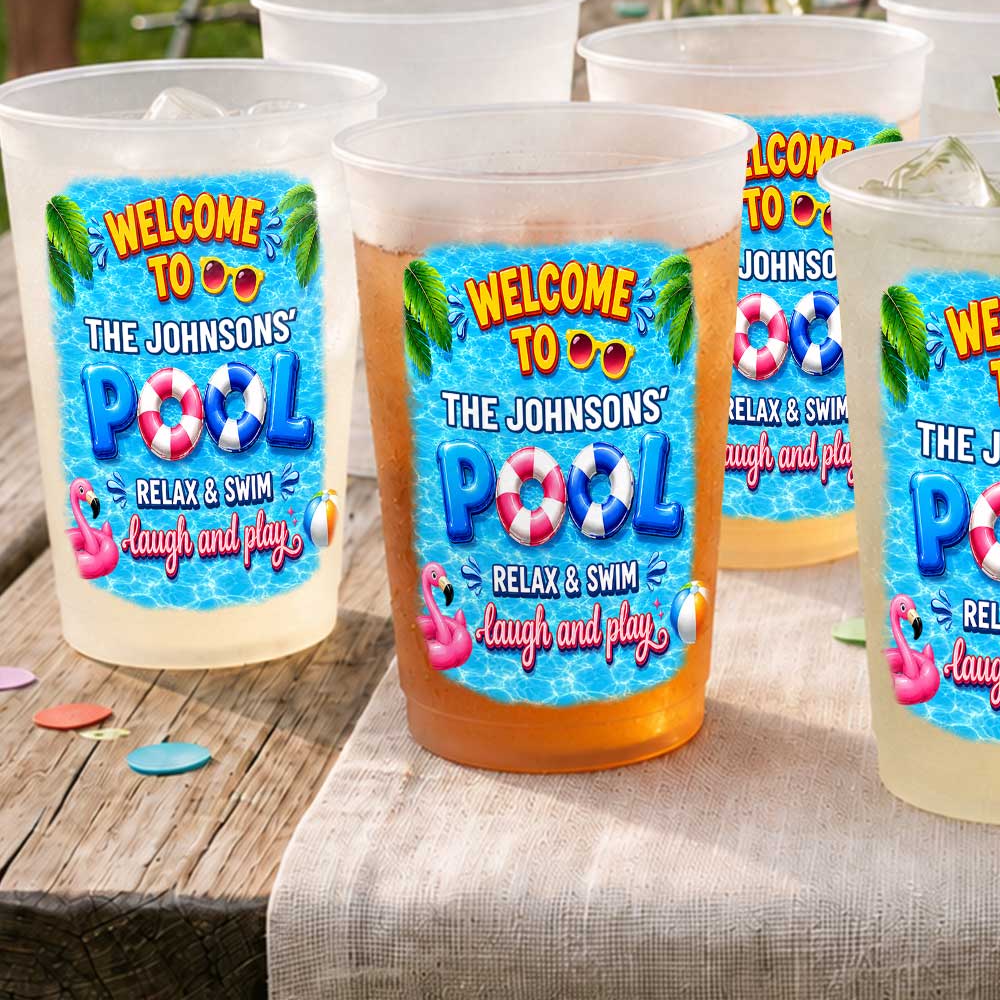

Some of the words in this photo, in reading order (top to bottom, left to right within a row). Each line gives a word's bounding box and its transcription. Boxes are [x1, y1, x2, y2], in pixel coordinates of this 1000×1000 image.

[746, 131, 856, 181] LCOM
[104, 192, 266, 260] WELCOME
[743, 185, 785, 232] TO
[148, 252, 193, 301] TO
[739, 249, 837, 282] JOHNSO
[464, 261, 637, 331] WELCOME
[84, 317, 138, 353] THE
[145, 307, 299, 355] JOHNSONS'
[510, 324, 559, 375] TO
[733, 290, 843, 381] OO
[80, 351, 314, 461] POOL
[441, 390, 499, 432] THE
[505, 386, 669, 434] JOHNSONS'
[786, 396, 801, 427] &
[805, 394, 848, 426] SWIM
[725, 430, 775, 491] augh
[777, 430, 819, 472] and
[915, 419, 974, 464] THE
[135, 477, 200, 508] RELAX
[204, 478, 219, 506] &
[224, 472, 273, 503] SWIM
[436, 431, 684, 546] POOL
[121, 513, 192, 579] laugh
[198, 512, 240, 558] and
[243, 509, 303, 572] play
[492, 563, 560, 599] RELAX
[564, 564, 580, 597] &
[585, 560, 639, 594] SWIM
[475, 603, 552, 671] laugh
[557, 603, 602, 650] and
[605, 599, 669, 664] play
